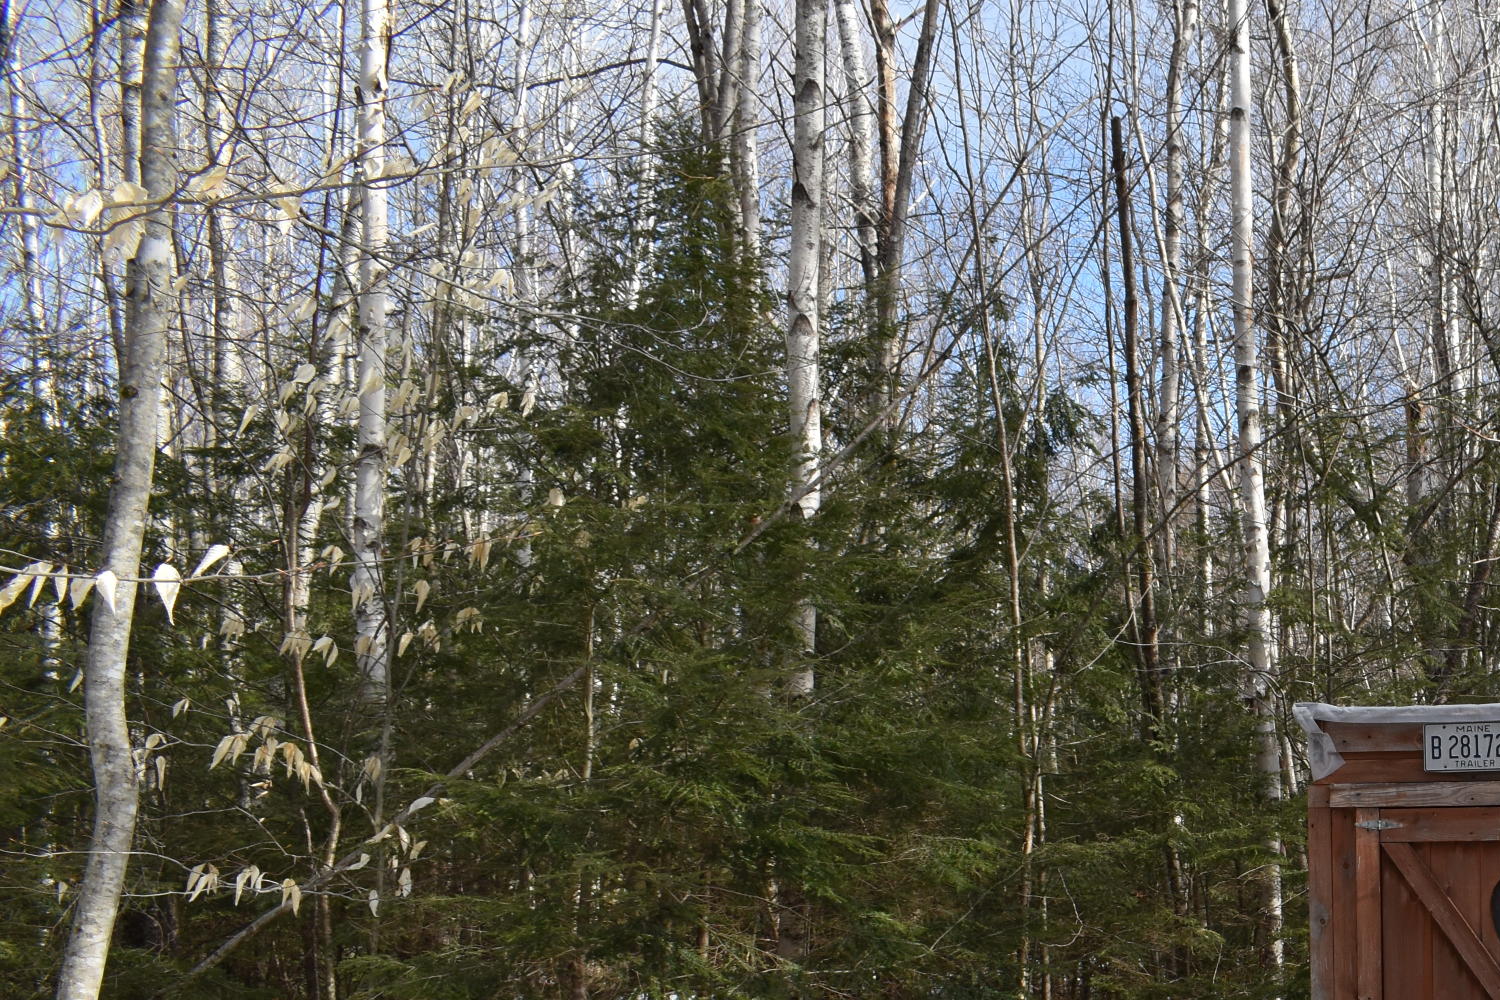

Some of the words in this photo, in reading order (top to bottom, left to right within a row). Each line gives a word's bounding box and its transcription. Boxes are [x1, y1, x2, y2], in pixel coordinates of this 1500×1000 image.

[1456, 724, 1491, 733] MAINE
[1431, 736, 1442, 760] B
[1455, 760, 1495, 768] TRAILER
